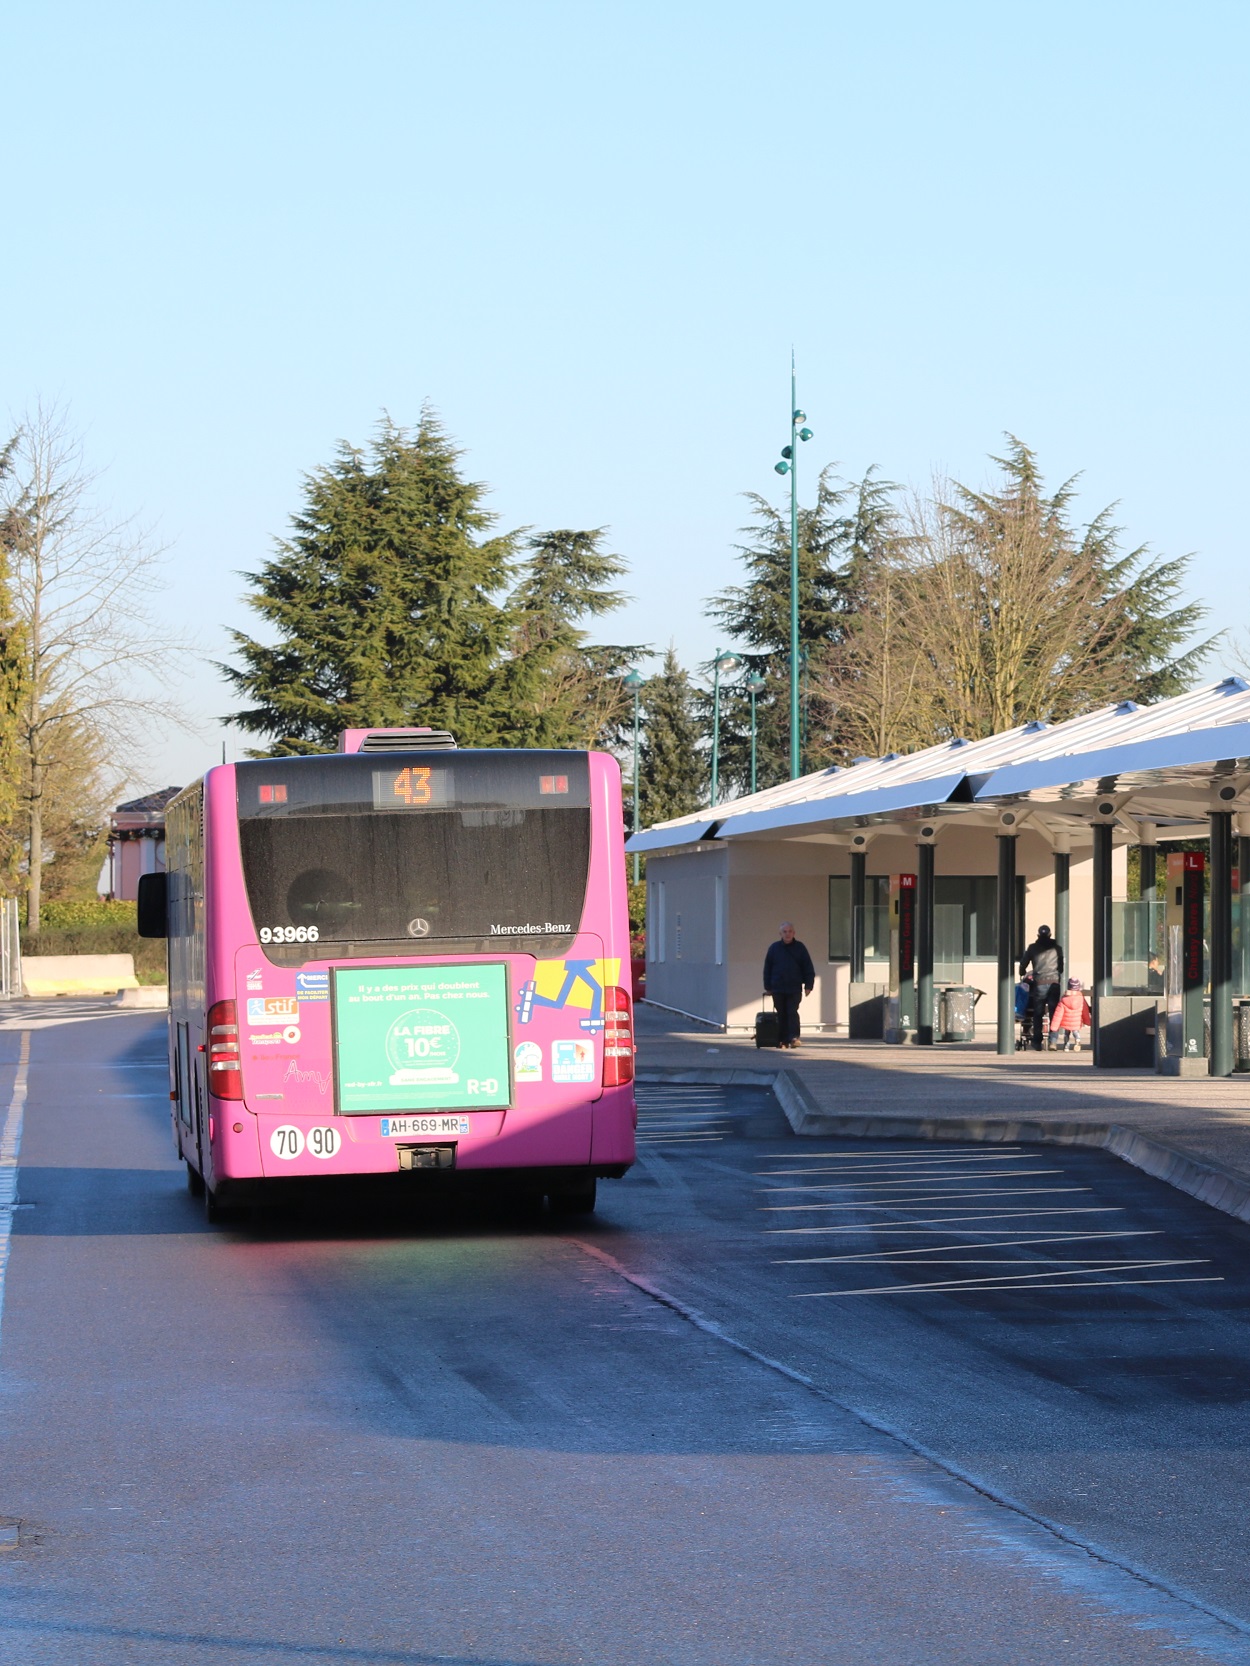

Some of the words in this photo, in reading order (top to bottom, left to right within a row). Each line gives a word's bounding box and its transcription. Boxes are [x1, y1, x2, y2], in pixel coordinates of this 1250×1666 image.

[393, 767, 431, 804] 43
[1189, 856, 1198, 868] L
[903, 877, 912, 886] M
[1190, 873, 1198, 899] Nord
[1189, 902, 1198, 935] Gares
[259, 925, 319, 944] 93966
[490, 922, 571, 936] Mercedes-Benz
[1188, 938, 1200, 979] Chessy
[358, 985, 364, 993] Il
[366, 986, 372, 994] y
[382, 984, 398, 992] des
[401, 983, 418, 993] prix
[421, 983, 436, 992] qui
[438, 981, 480, 990] doublent
[362, 994, 384, 1002] bout
[424, 992, 440, 1000] Pas
[466, 991, 490, 999] nous.
[267, 999, 296, 1014] stif
[393, 1026, 411, 1036] LA
[414, 1025, 450, 1035] FIBRE
[467, 1078, 498, 1095] RED
[391, 1117, 459, 1133] AH-669-MR
[277, 1129, 298, 1155] 70
[313, 1127, 334, 1155] 90
